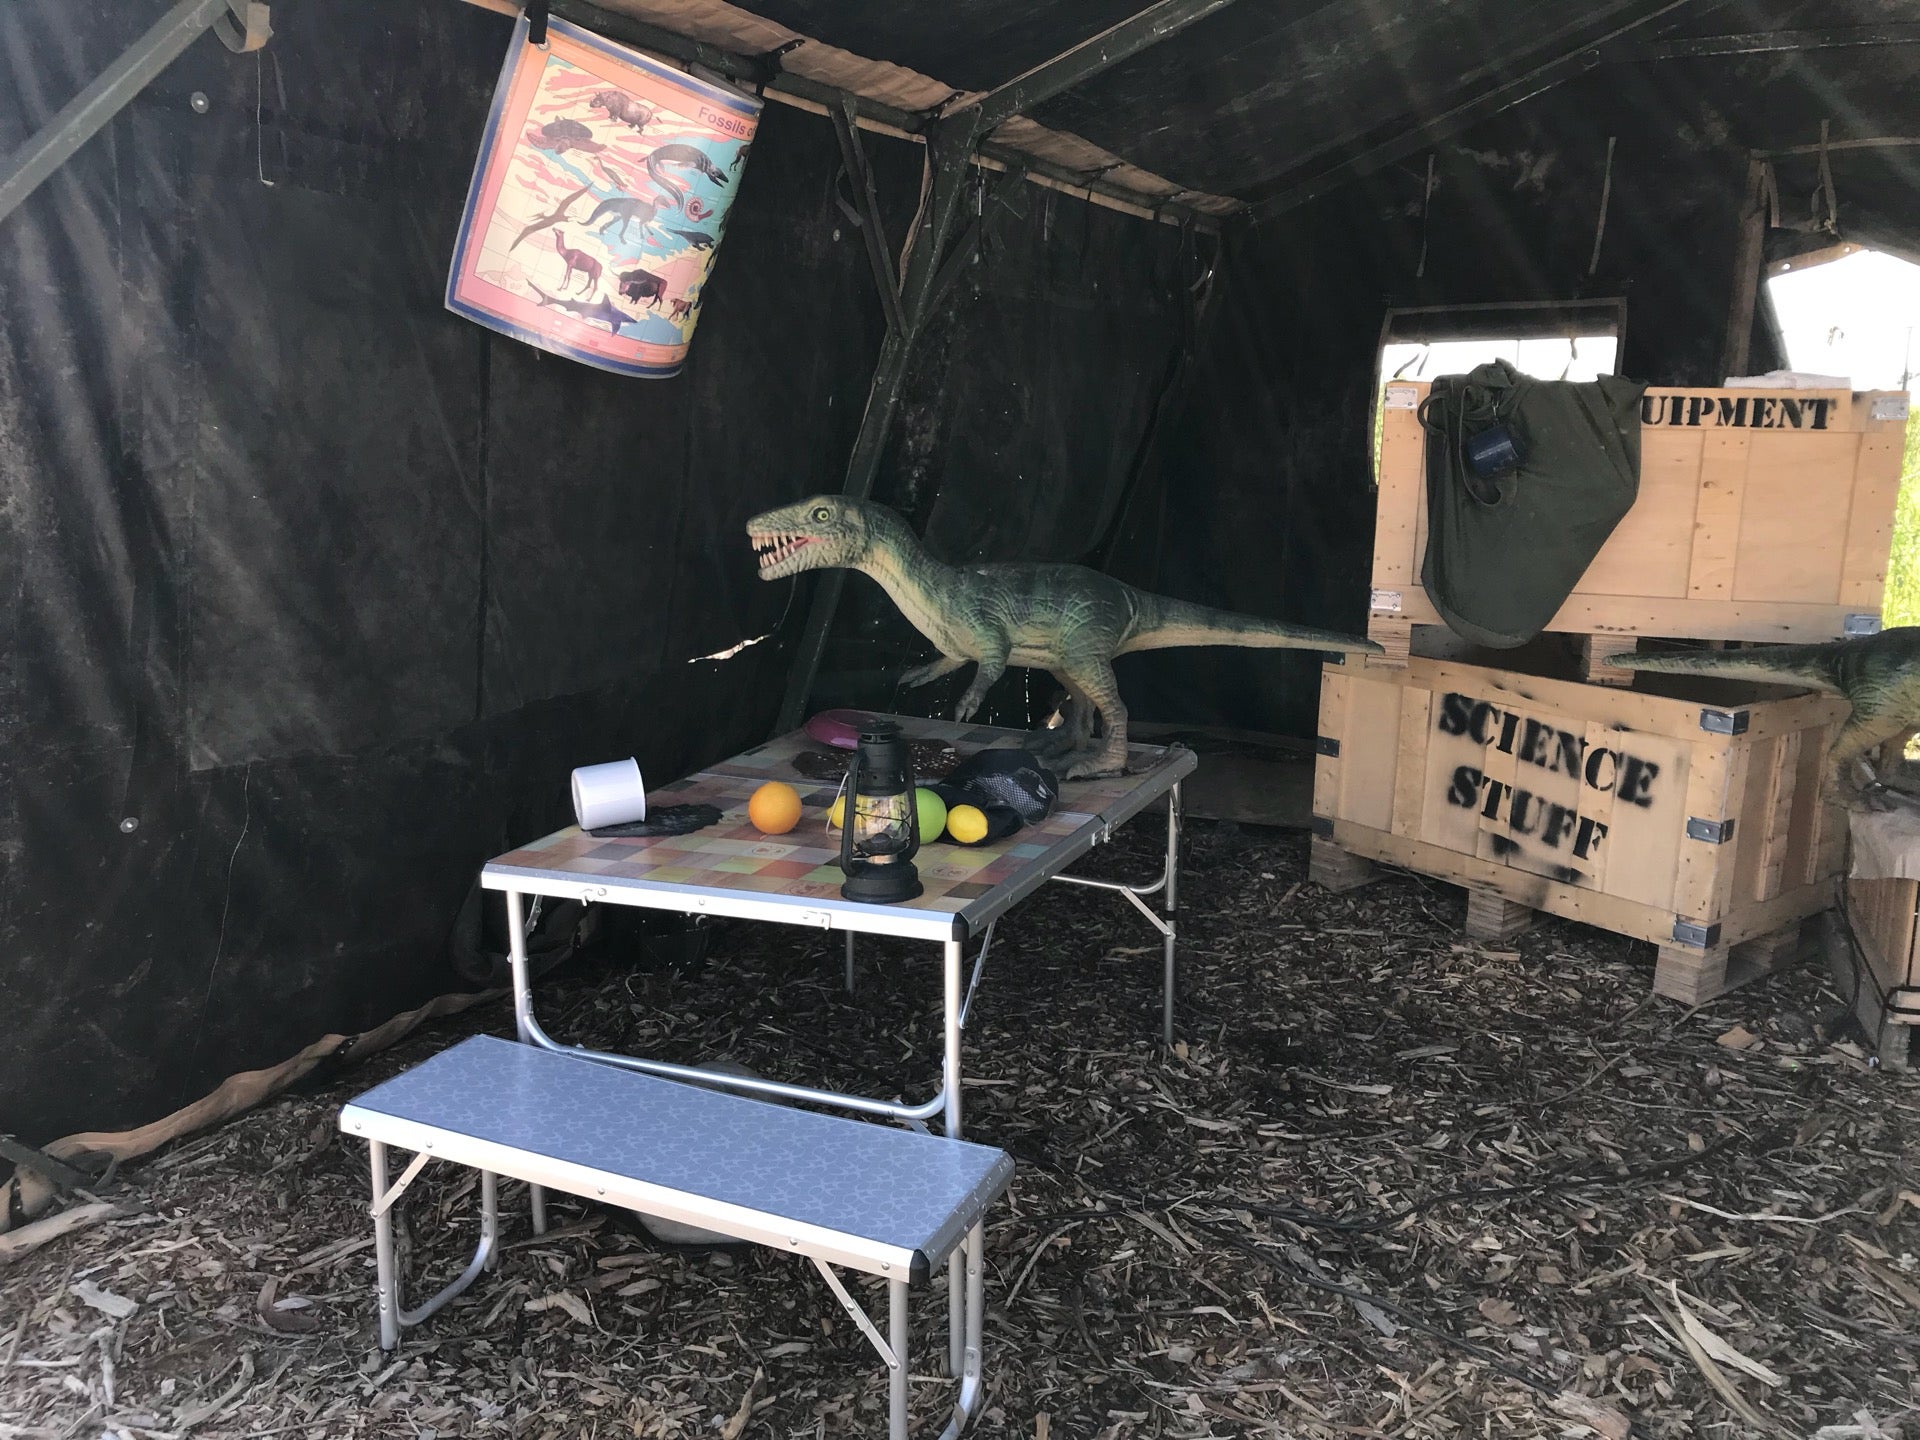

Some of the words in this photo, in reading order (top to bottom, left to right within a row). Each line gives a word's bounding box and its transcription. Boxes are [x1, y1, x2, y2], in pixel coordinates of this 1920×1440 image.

[698, 106, 746, 135] Fossils
[1641, 396, 1835, 430] UIPMENT
[1439, 692, 1659, 808] SCIENCE
[1448, 765, 1608, 861] STUFF
